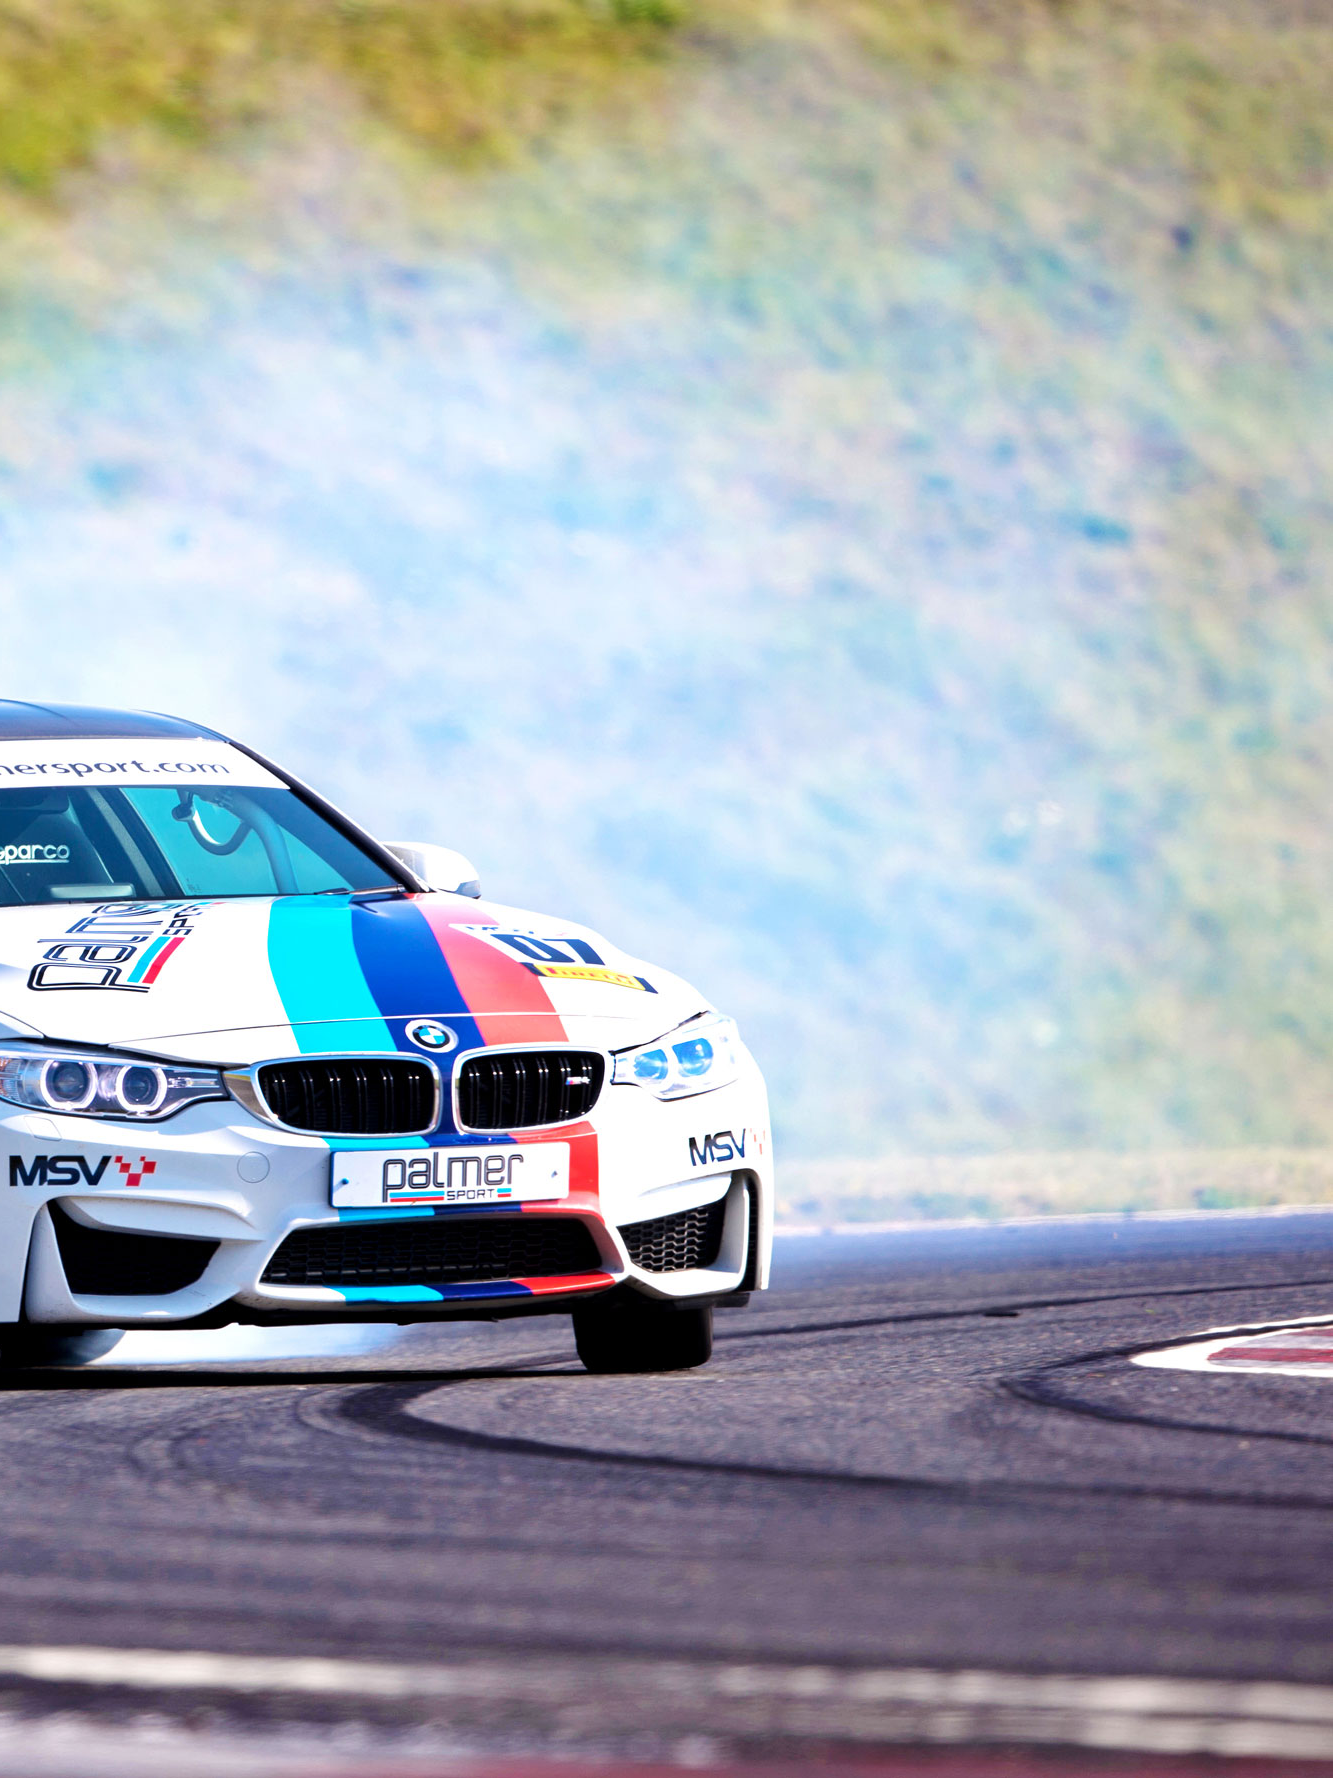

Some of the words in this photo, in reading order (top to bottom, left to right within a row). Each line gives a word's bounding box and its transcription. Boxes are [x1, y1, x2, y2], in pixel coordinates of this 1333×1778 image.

[688, 1128, 746, 1167] MSV
[9, 1155, 112, 1187] MSV
[382, 1151, 524, 1203] palmer
[446, 1188, 495, 1201] SPORT
